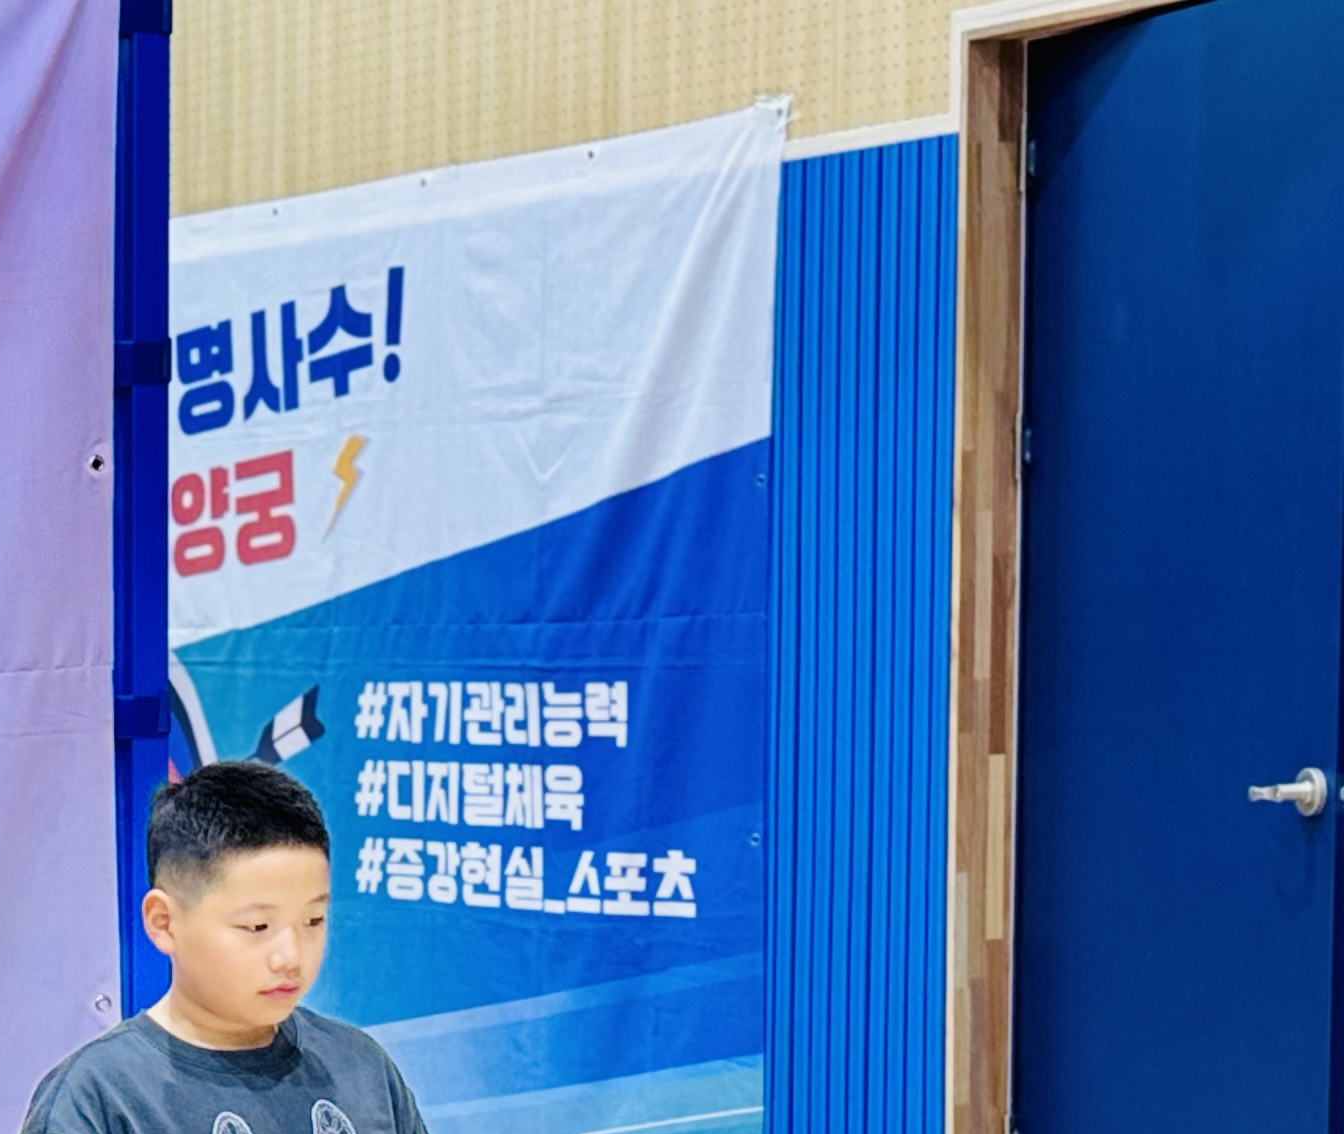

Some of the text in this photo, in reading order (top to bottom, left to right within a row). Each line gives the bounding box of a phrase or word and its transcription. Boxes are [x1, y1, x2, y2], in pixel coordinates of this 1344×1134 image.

[176, 265, 405, 436] 명사수!
[170, 449, 296, 577] 양궁
[354, 680, 629, 748] #자기관리능력
[354, 759, 585, 831] #디지털체육
[354, 836, 698, 918] #증강현실_스포츠
